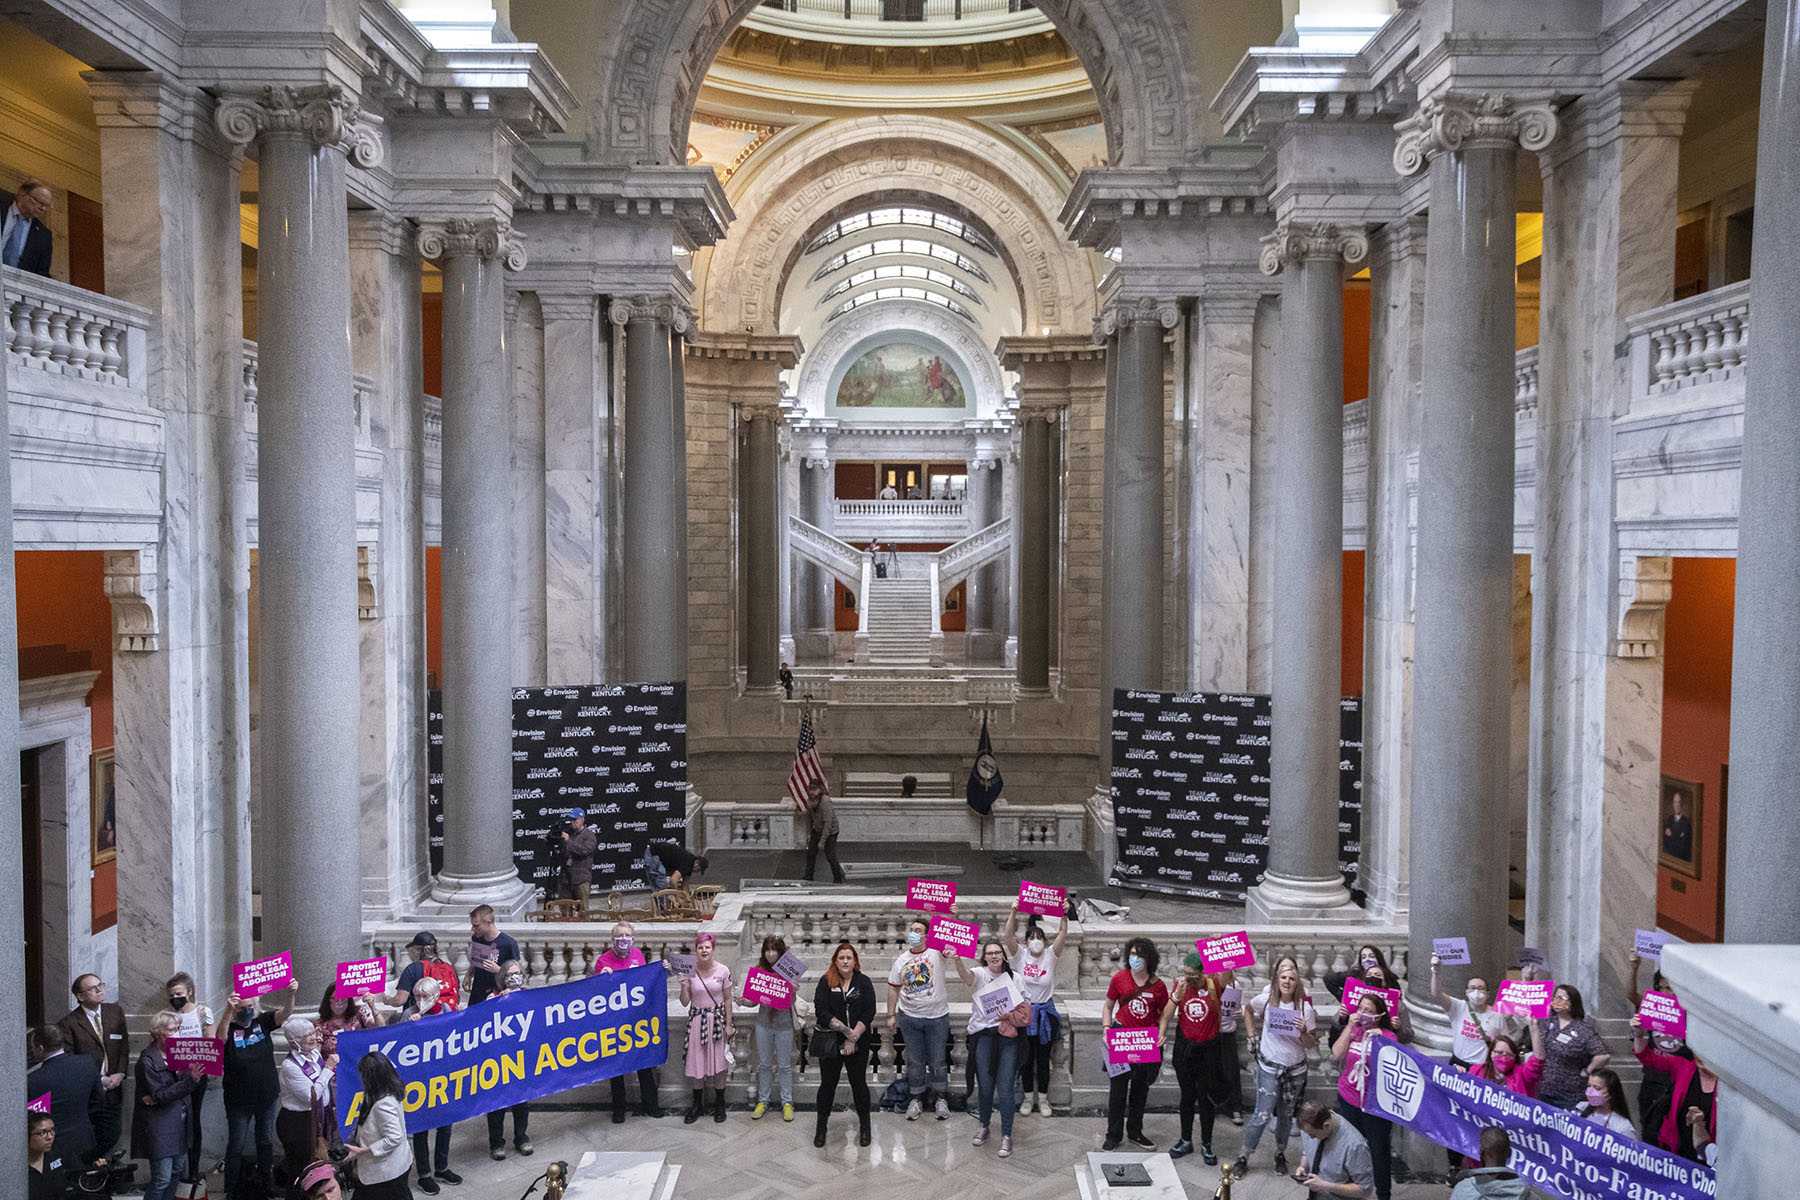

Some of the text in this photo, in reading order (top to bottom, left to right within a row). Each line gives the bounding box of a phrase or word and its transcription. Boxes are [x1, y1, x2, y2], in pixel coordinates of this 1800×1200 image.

[612, 882, 646, 890] KENTUCKY
[1028, 885, 1059, 895] PROTECT
[913, 894, 949, 903] ABORTION
[1023, 897, 1059, 907] ABORTION
[940, 920, 971, 932] PROTECT
[934, 932, 971, 946] ABORTION
[954, 931, 974, 940] LEGAL
[1206, 936, 1238, 948] PROTECT
[1224, 941, 1246, 951] LEGAL
[1208, 948, 1245, 961] ABORTION
[244, 957, 282, 972] PROTECT
[264, 963, 289, 975] LEGAL
[348, 961, 379, 971] PROTECT
[365, 967, 383, 976] LEGAL
[776, 963, 794, 978] BODIES
[788, 966, 800, 976] OUR
[242, 970, 287, 987] ABORTION
[344, 975, 381, 986] ABORTION
[756, 973, 786, 986] PROTECT
[751, 984, 786, 998] ABORTION
[769, 983, 789, 994] LEGAL
[1510, 983, 1545, 991] PROTECT
[1502, 995, 1544, 1005] ABORTION
[370, 983, 645, 1068] Kentucky needs
[345, 1017, 661, 1126] AORTION ACCESS!
[1432, 1065, 1482, 1104] Kentucky
[1483, 1085, 1530, 1120] Religious
[1533, 1106, 1581, 1142] Coalition
[1583, 1126, 1602, 1150] for
[1602, 1134, 1688, 1184] Reproductive
